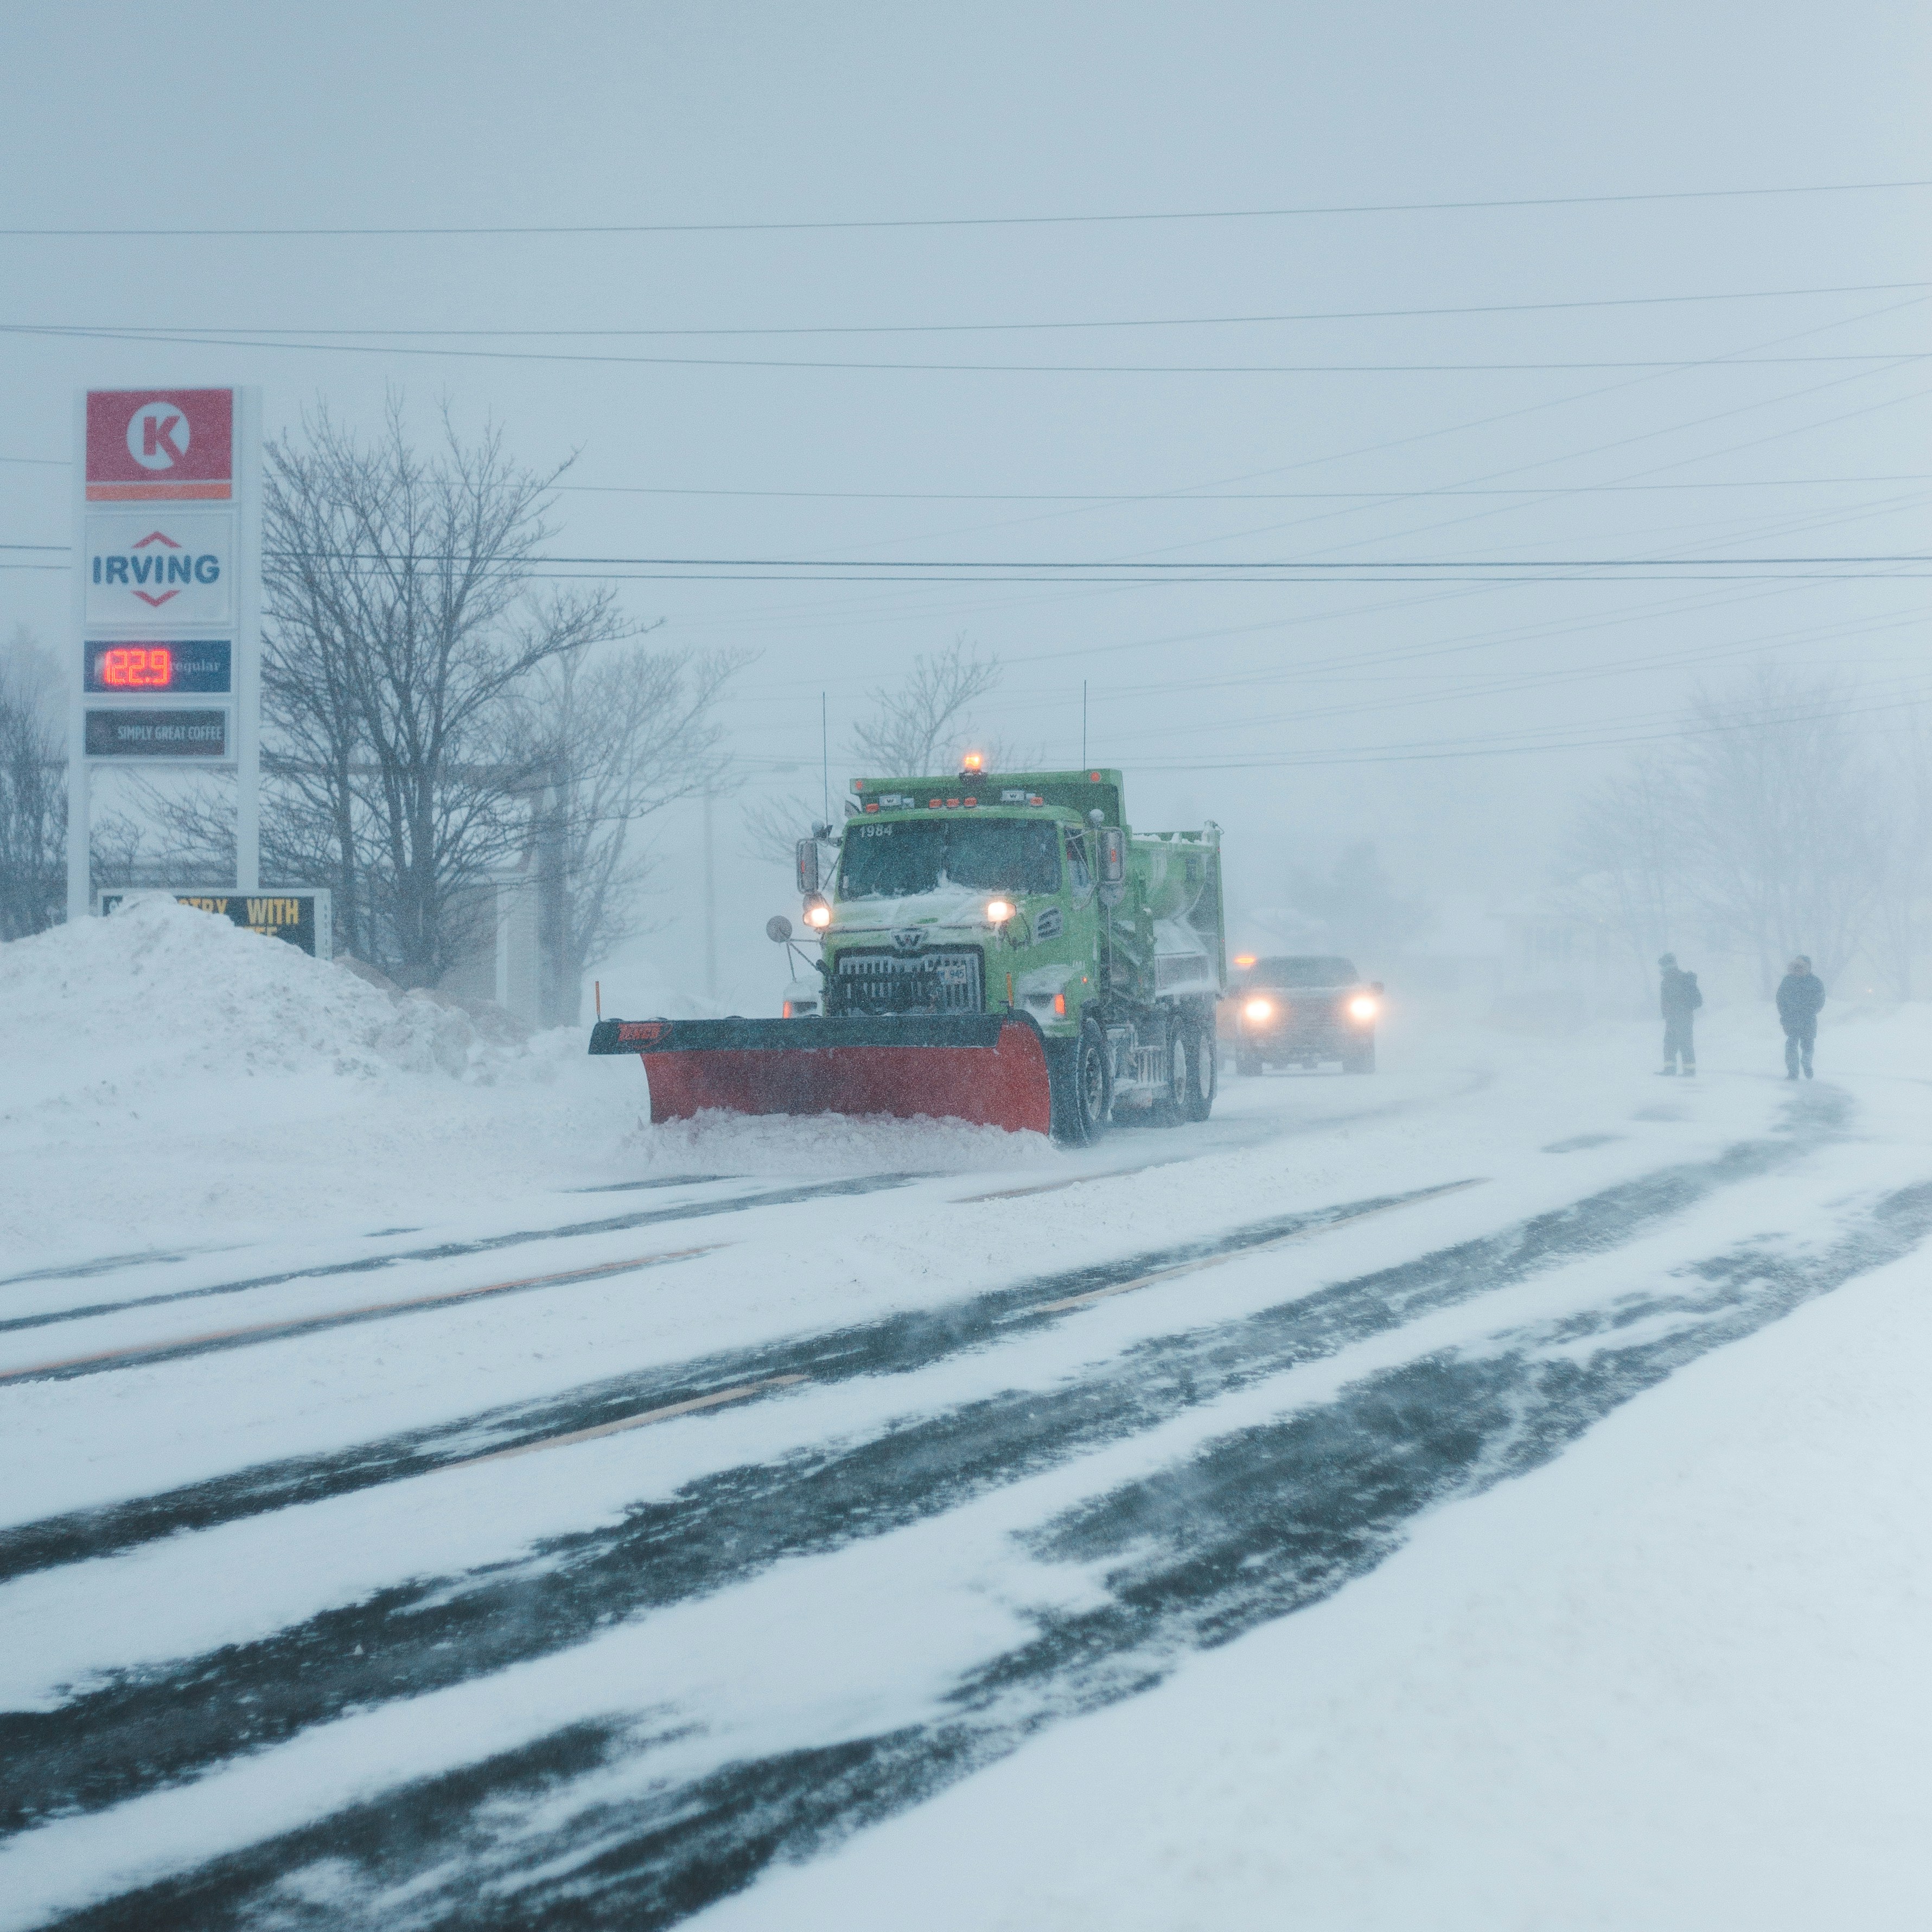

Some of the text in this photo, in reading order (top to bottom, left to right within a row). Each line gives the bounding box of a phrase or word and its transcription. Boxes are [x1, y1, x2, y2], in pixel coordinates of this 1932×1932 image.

[143, 415, 186, 467] K
[92, 554, 220, 585] IRVING
[105, 649, 168, 684] 122.9
[118, 725, 222, 740] SIMPLY GREAT COFFEE
[859, 824, 893, 838] 1984
[247, 898, 298, 924] WITH
